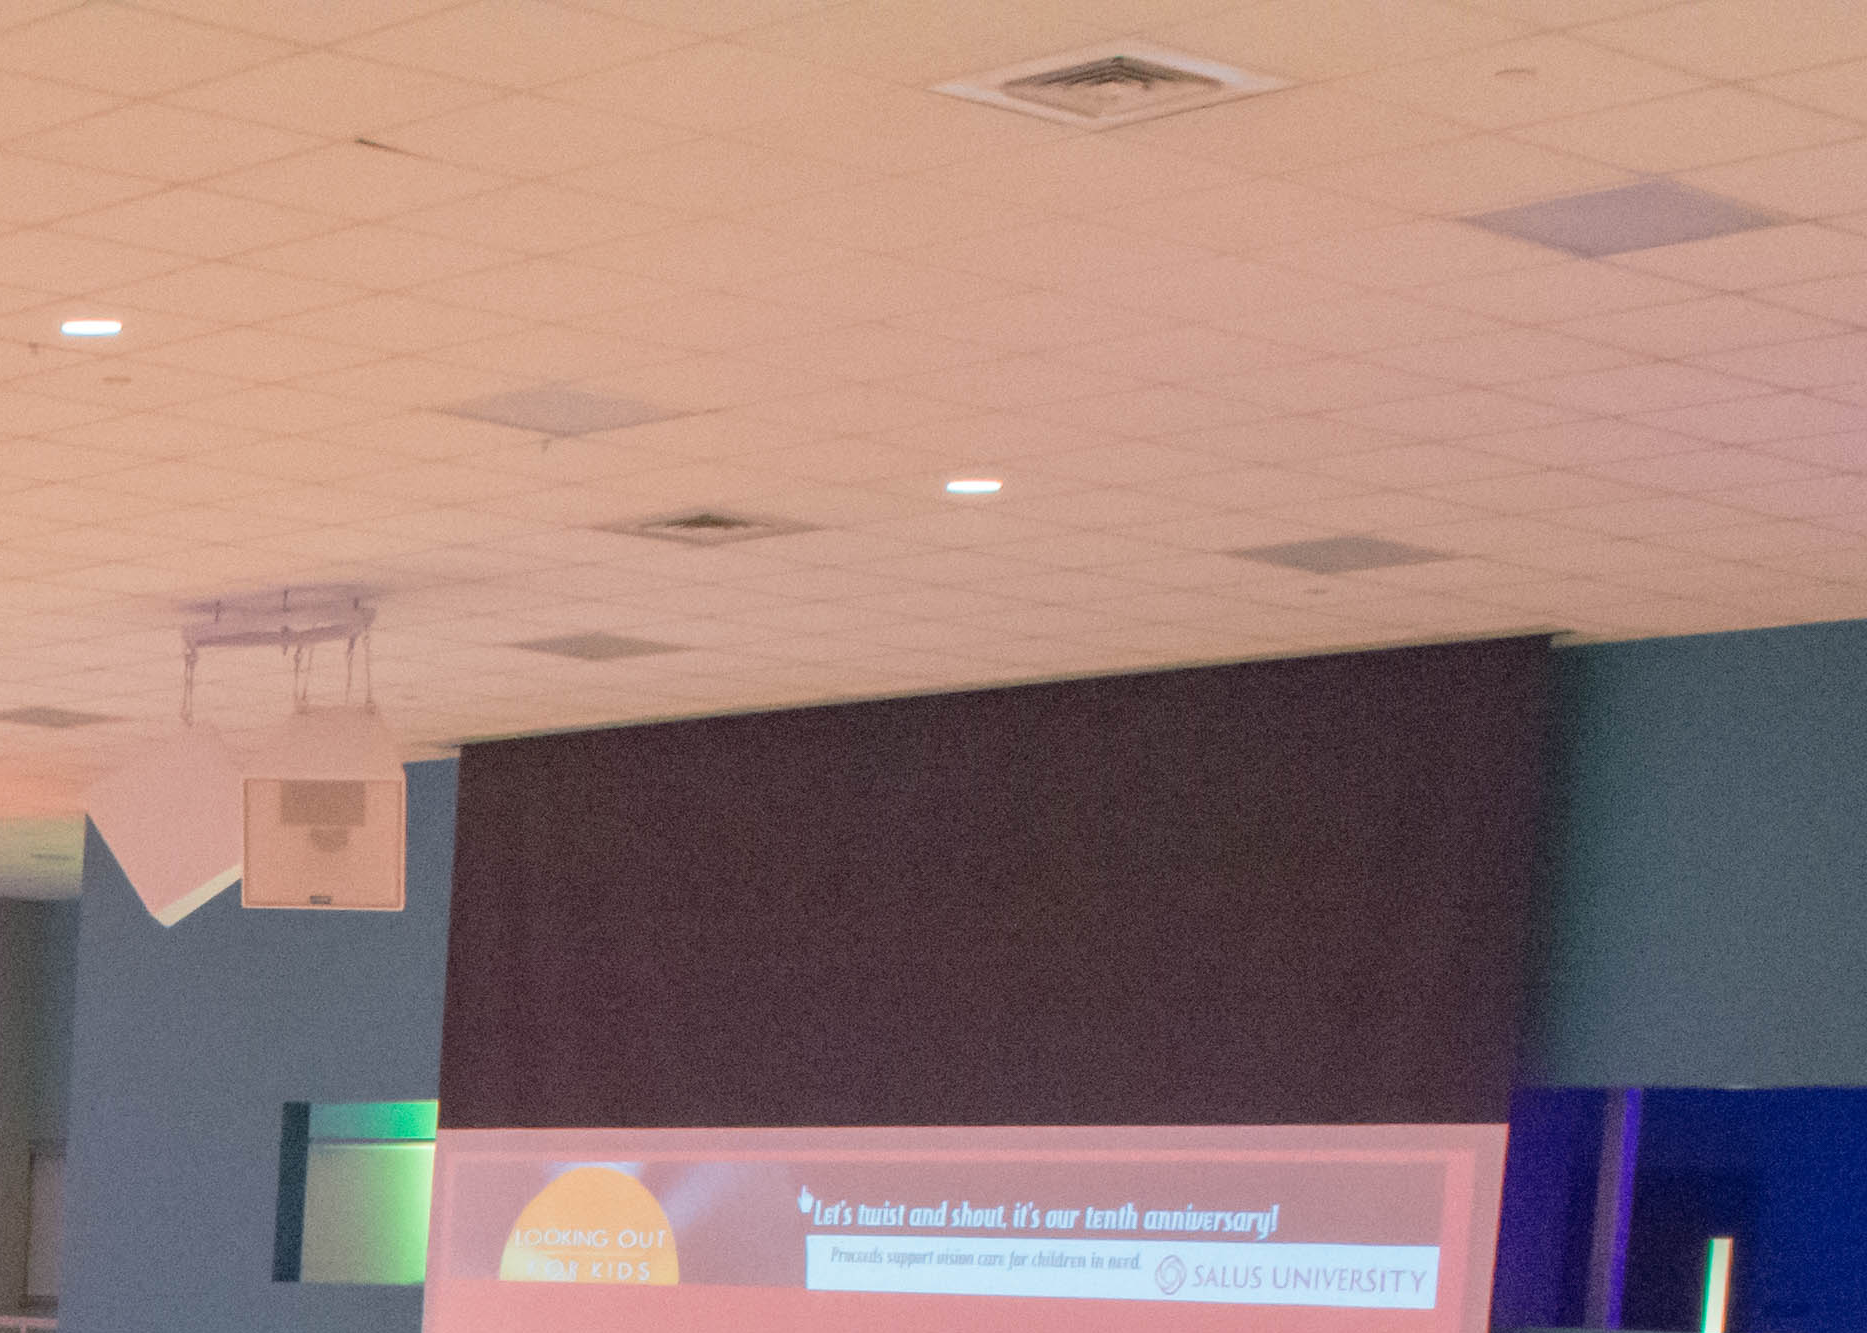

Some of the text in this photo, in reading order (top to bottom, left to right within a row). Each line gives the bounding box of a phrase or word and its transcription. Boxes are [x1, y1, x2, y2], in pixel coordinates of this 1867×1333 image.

[814, 1201, 1280, 1241] Let's twist and shout, it's our tenth anniversary!
[515, 1228, 665, 1249] LOOKING OUT
[887, 1250, 935, 1268] support
[938, 1249, 976, 1265] vision
[978, 1254, 1006, 1267] care
[1009, 1252, 1029, 1270] for
[1031, 1251, 1087, 1268] children
[1091, 1254, 1105, 1268] in
[592, 1261, 650, 1281] KIDS
[1192, 1264, 1427, 1295] SALUS UNIVERSITY
